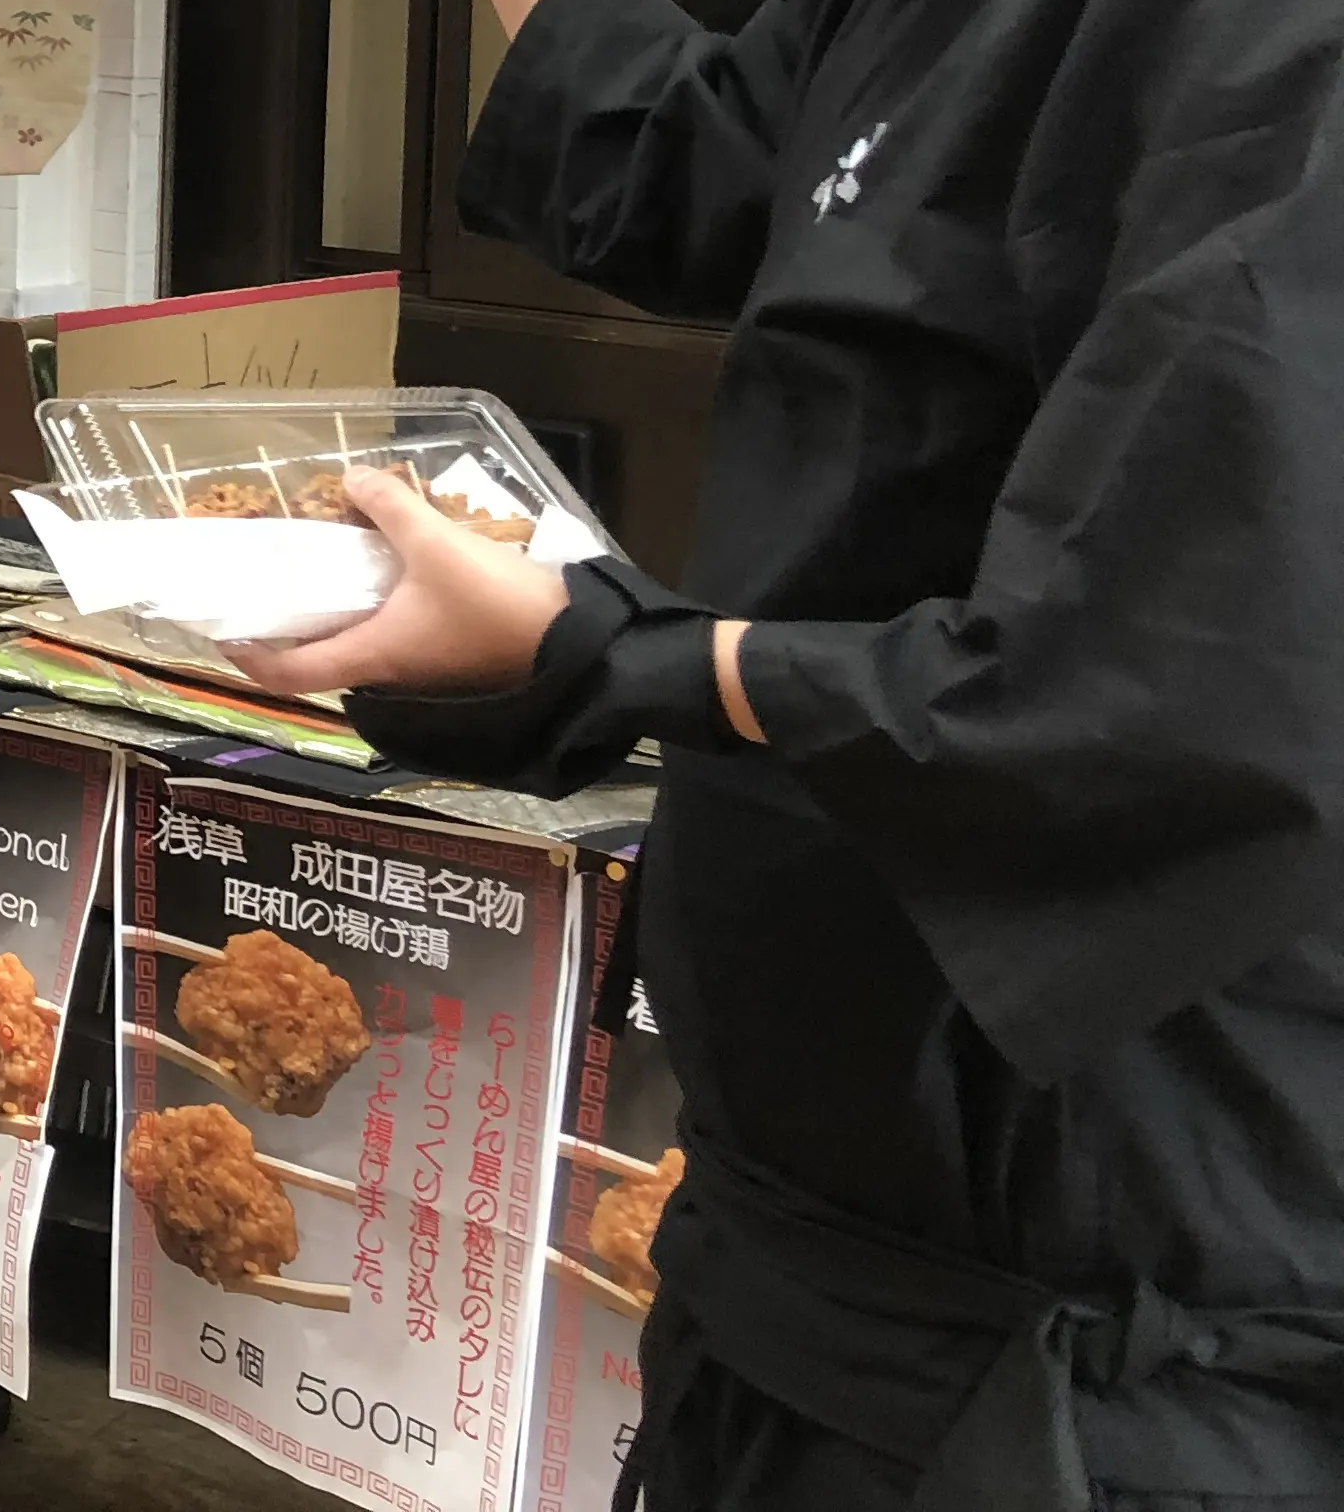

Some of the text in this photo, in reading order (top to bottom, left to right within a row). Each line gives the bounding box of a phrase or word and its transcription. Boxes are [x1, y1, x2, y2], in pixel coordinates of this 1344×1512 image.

[153, 805, 526, 937] 浅草 成田屋名物
[222, 876, 451, 972] 昭和の揚げ鶏
[296, 1371, 438, 1467] 500円
